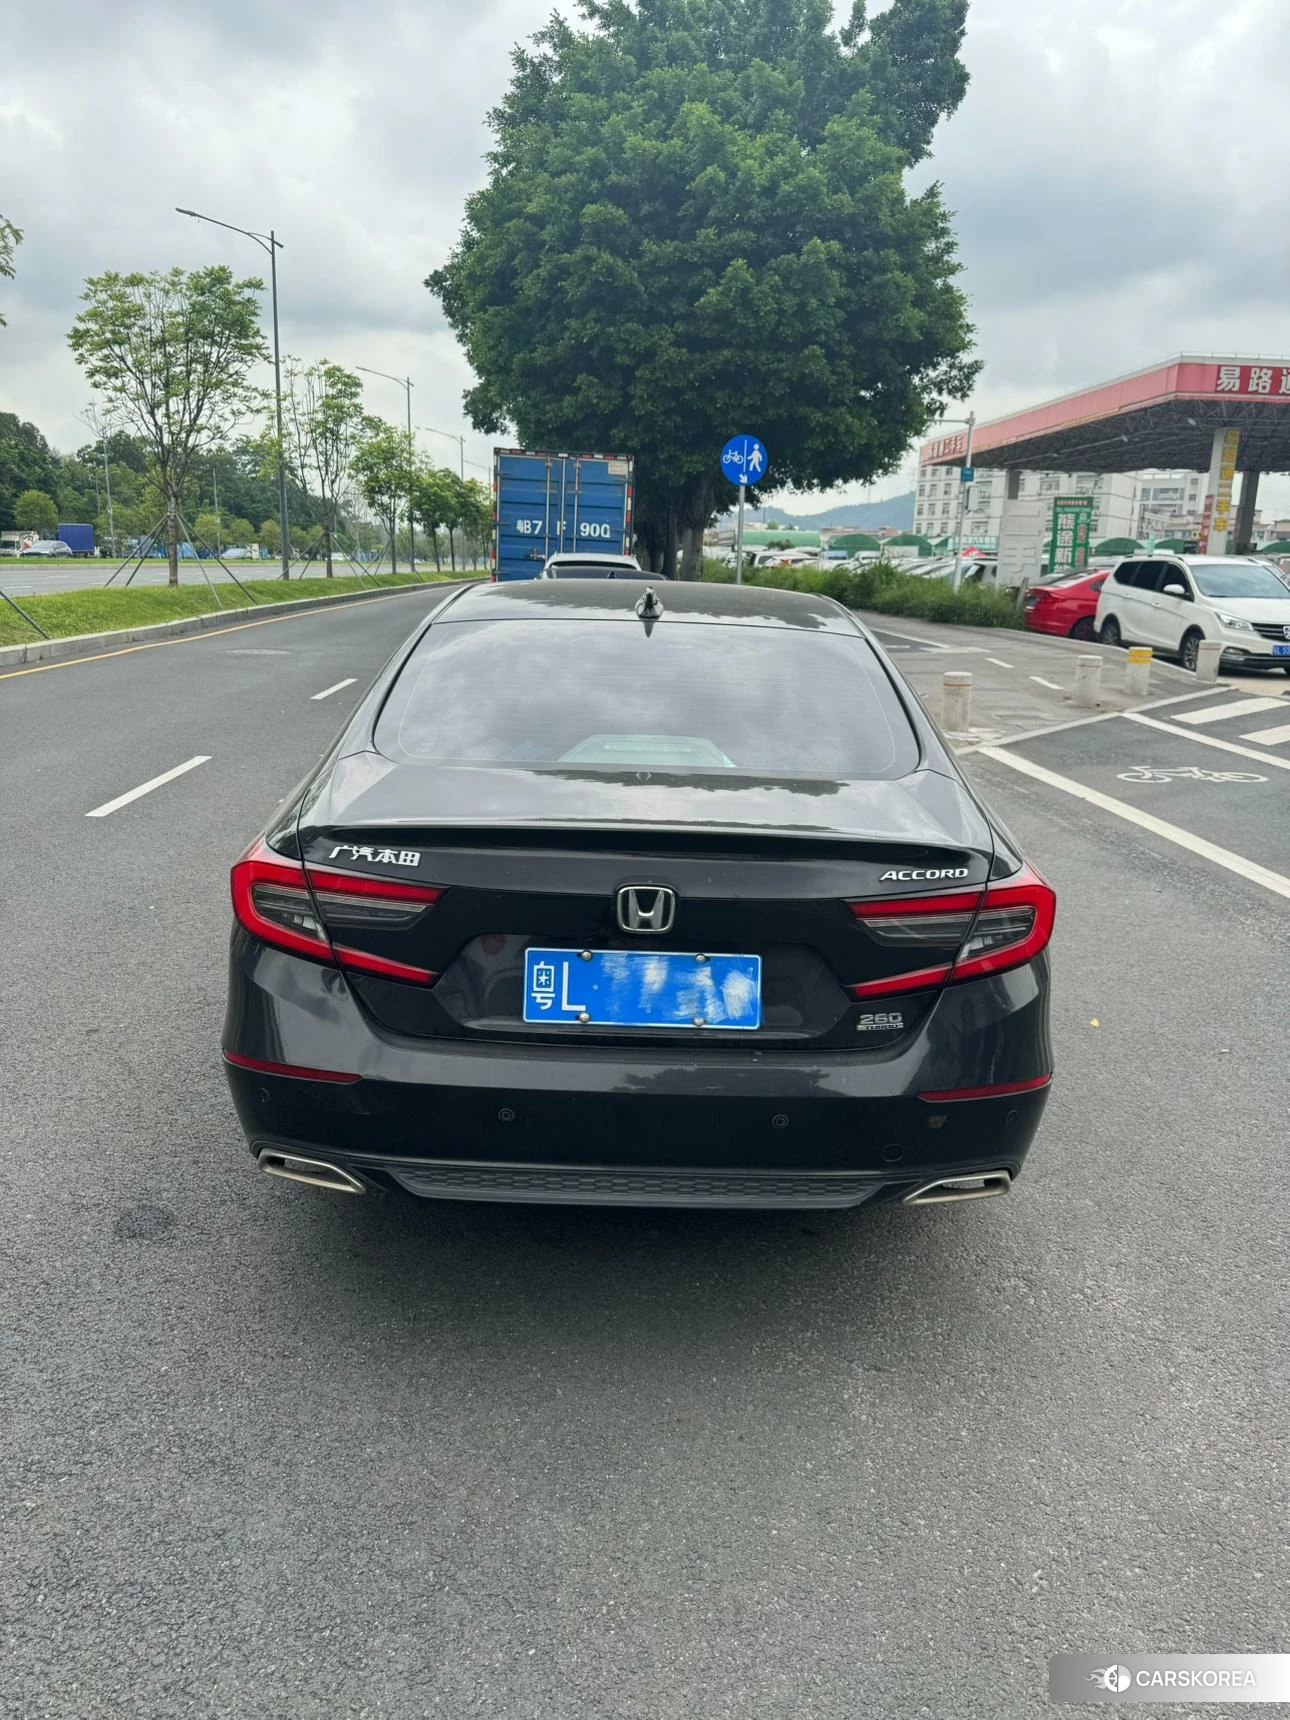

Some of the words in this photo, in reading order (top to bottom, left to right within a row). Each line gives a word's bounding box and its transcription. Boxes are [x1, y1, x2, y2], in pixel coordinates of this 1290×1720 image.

[328, 845, 421, 867] 广汽本田
[879, 868, 969, 881] ACCORD
[860, 1012, 903, 1025] 260
